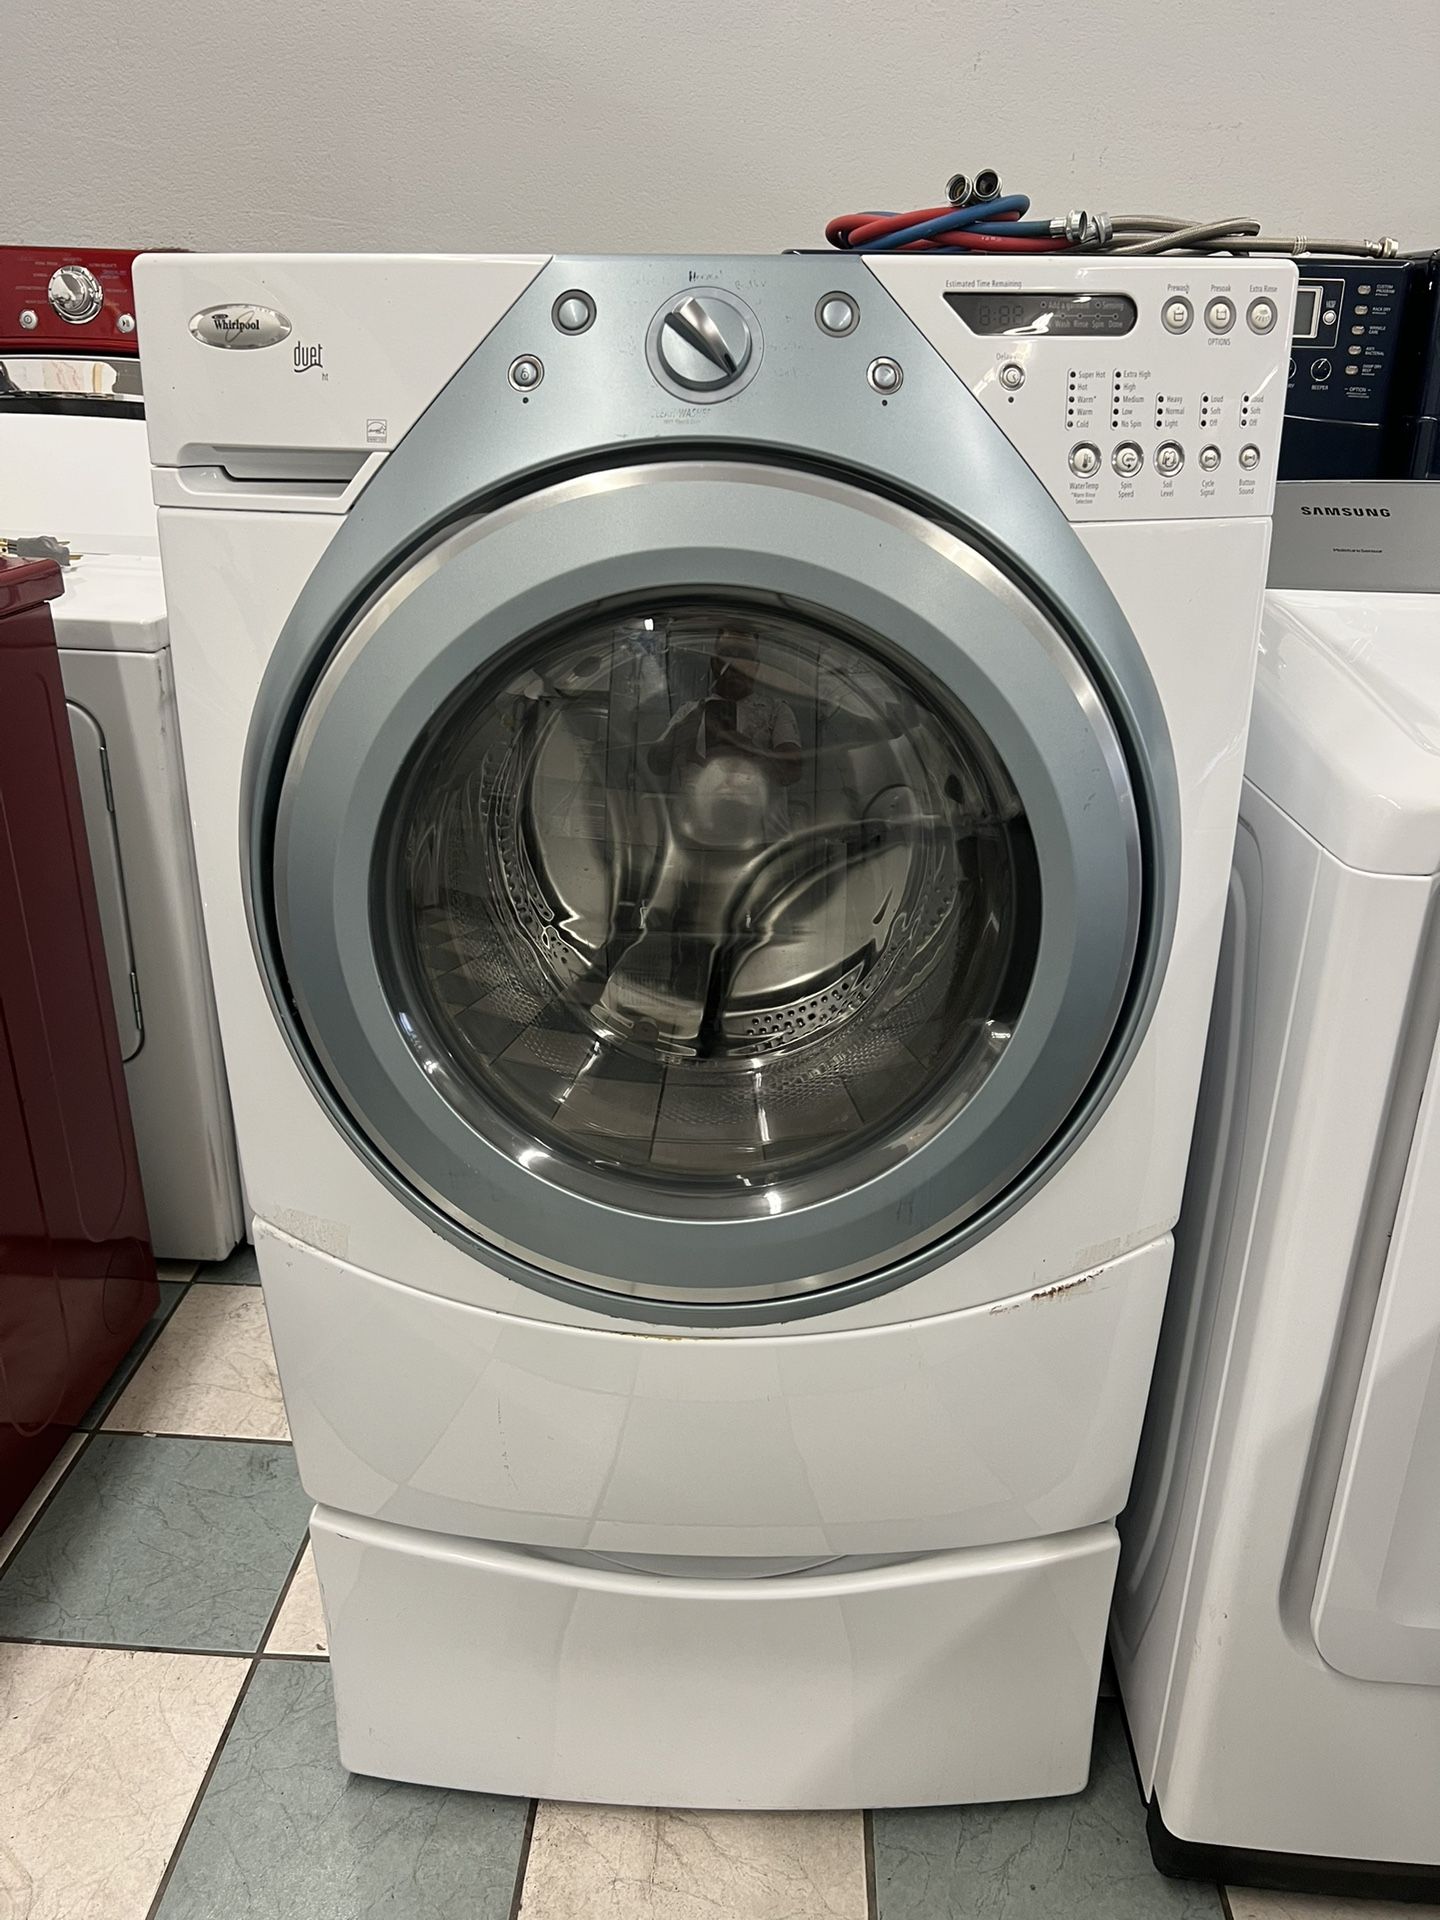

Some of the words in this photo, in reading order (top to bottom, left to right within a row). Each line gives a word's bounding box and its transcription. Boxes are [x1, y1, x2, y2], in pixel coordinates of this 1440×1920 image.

[946, 280, 975, 288] Estimated
[976, 280, 990, 288] Time
[992, 280, 1022, 289] Remaining
[1167, 284, 1190, 292] Prewash
[1211, 284, 1231, 292] Presoak
[1264, 285, 1278, 293] Rinse
[214, 319, 260, 332] Whirlpool
[294, 341, 323, 372] duet
[1078, 371, 1094, 379] Super
[1139, 371, 1151, 380] High
[1124, 383, 1136, 392] High
[1167, 396, 1182, 404] Heavy
[1210, 407, 1221, 415] Soft
[1076, 420, 1088, 428] Cold
[1130, 421, 1142, 429] Spin
[1165, 420, 1178, 429] Light
[1121, 481, 1132, 489] Spin
[1163, 480, 1172, 488] Soil
[1202, 480, 1214, 488] Cycle
[1118, 490, 1134, 500] Speed
[1200, 489, 1215, 497] Signal
[1301, 506, 1391, 517] SAMSUNG
